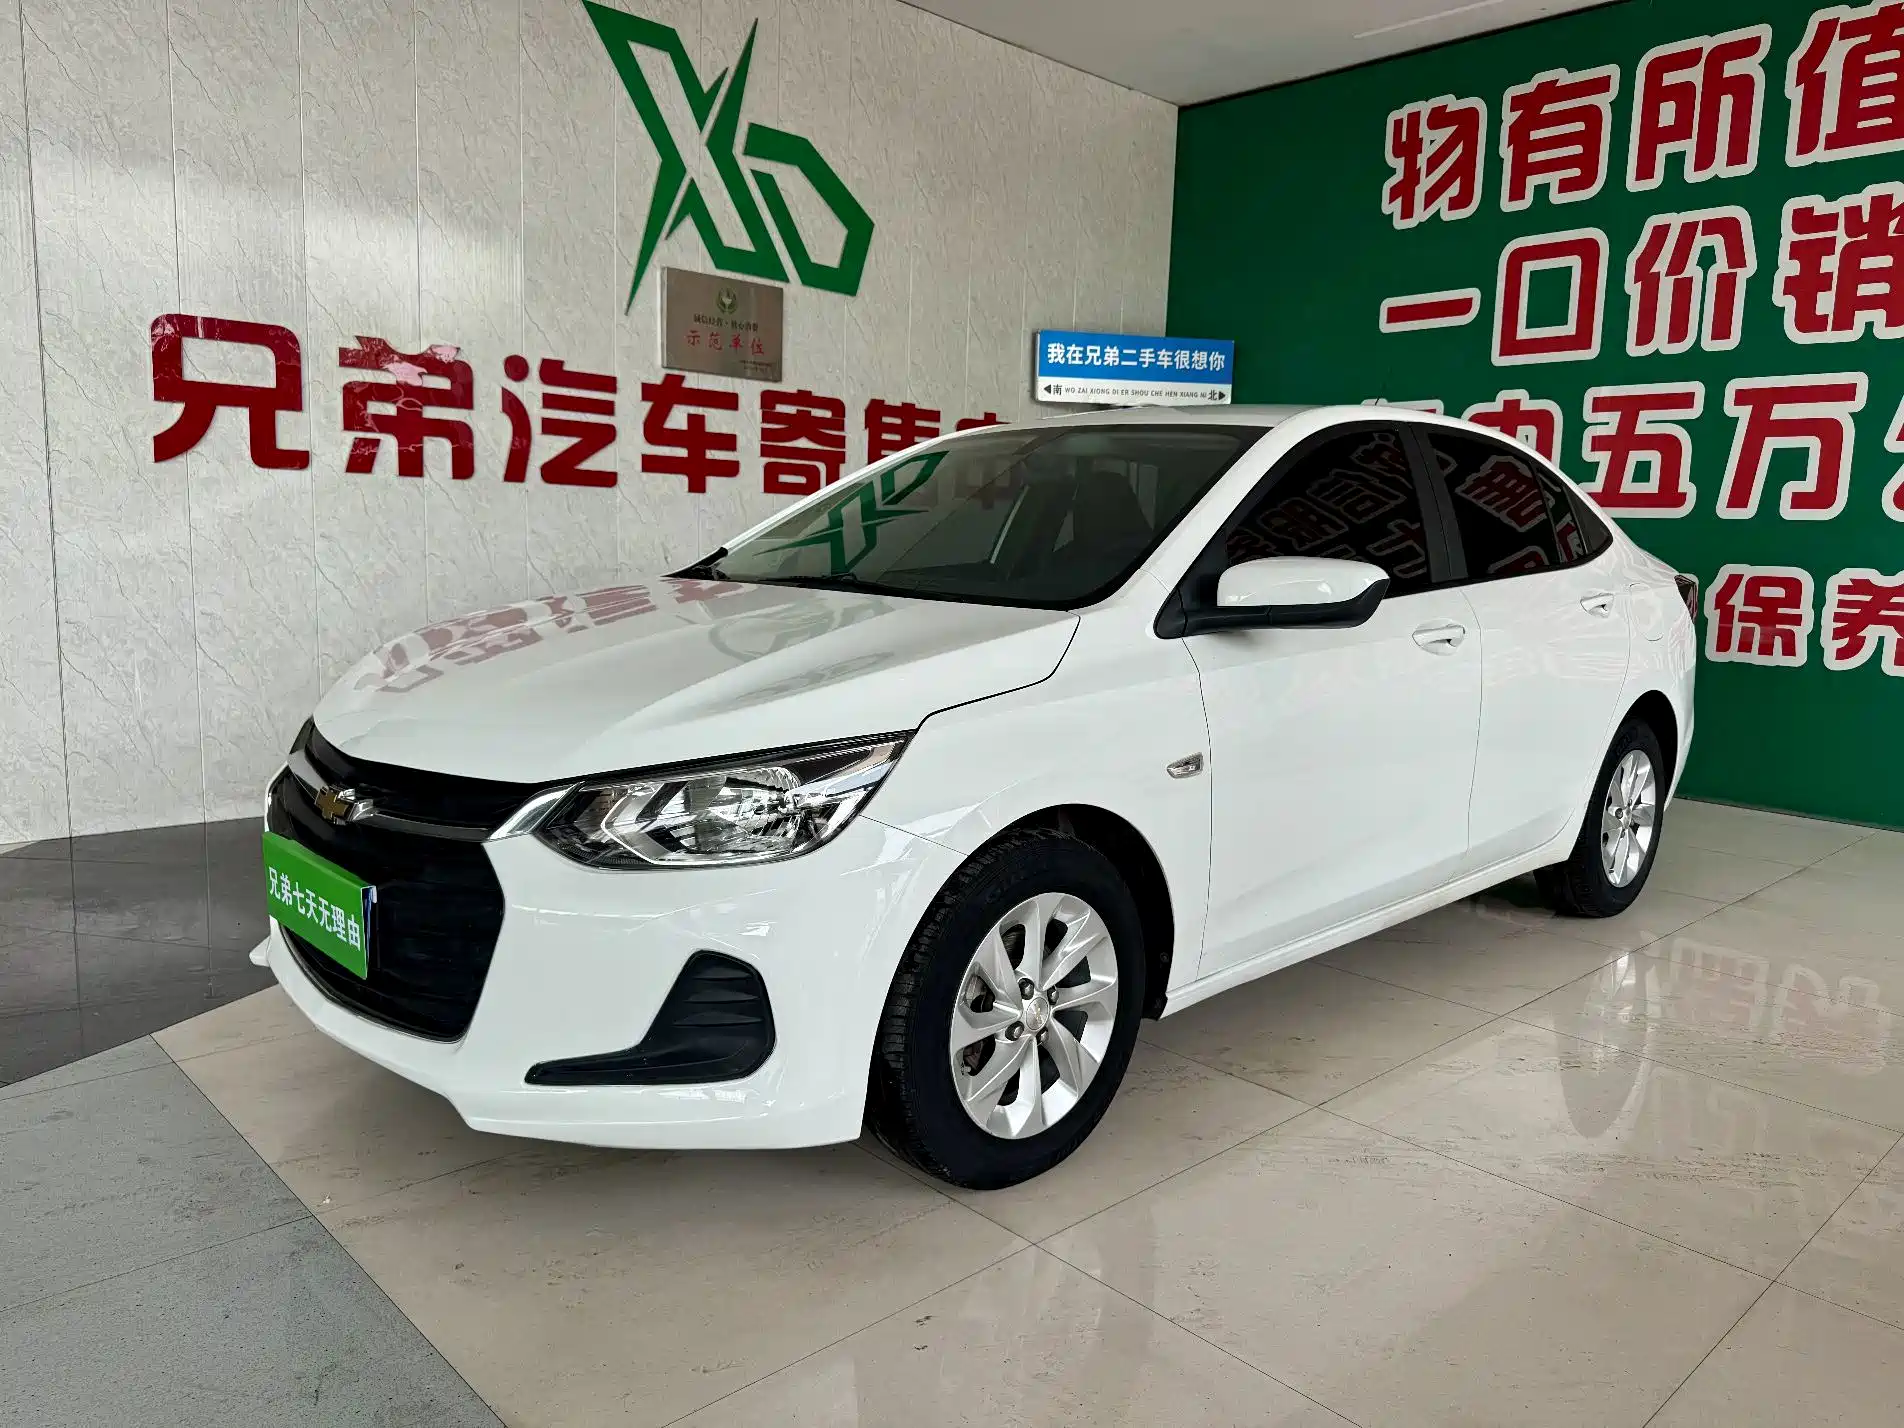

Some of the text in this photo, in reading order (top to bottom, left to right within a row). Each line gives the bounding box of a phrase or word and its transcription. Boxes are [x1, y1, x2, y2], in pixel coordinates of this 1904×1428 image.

[1384, 0, 1904, 222] 物有所值
[1384, 186, 1904, 358] 一口价销
[687, 329, 766, 355] 示范单位
[1047, 343, 1225, 371] 我在兄弟二手车很想你
[1053, 383, 1063, 396] 南
[1089, 387, 1110, 395] XIONG
[1131, 389, 1149, 397] SHOU
[1165, 390, 1178, 398] HEN
[1207, 389, 1218, 401] 北
[268, 866, 362, 952] 兄弟七天无理由
